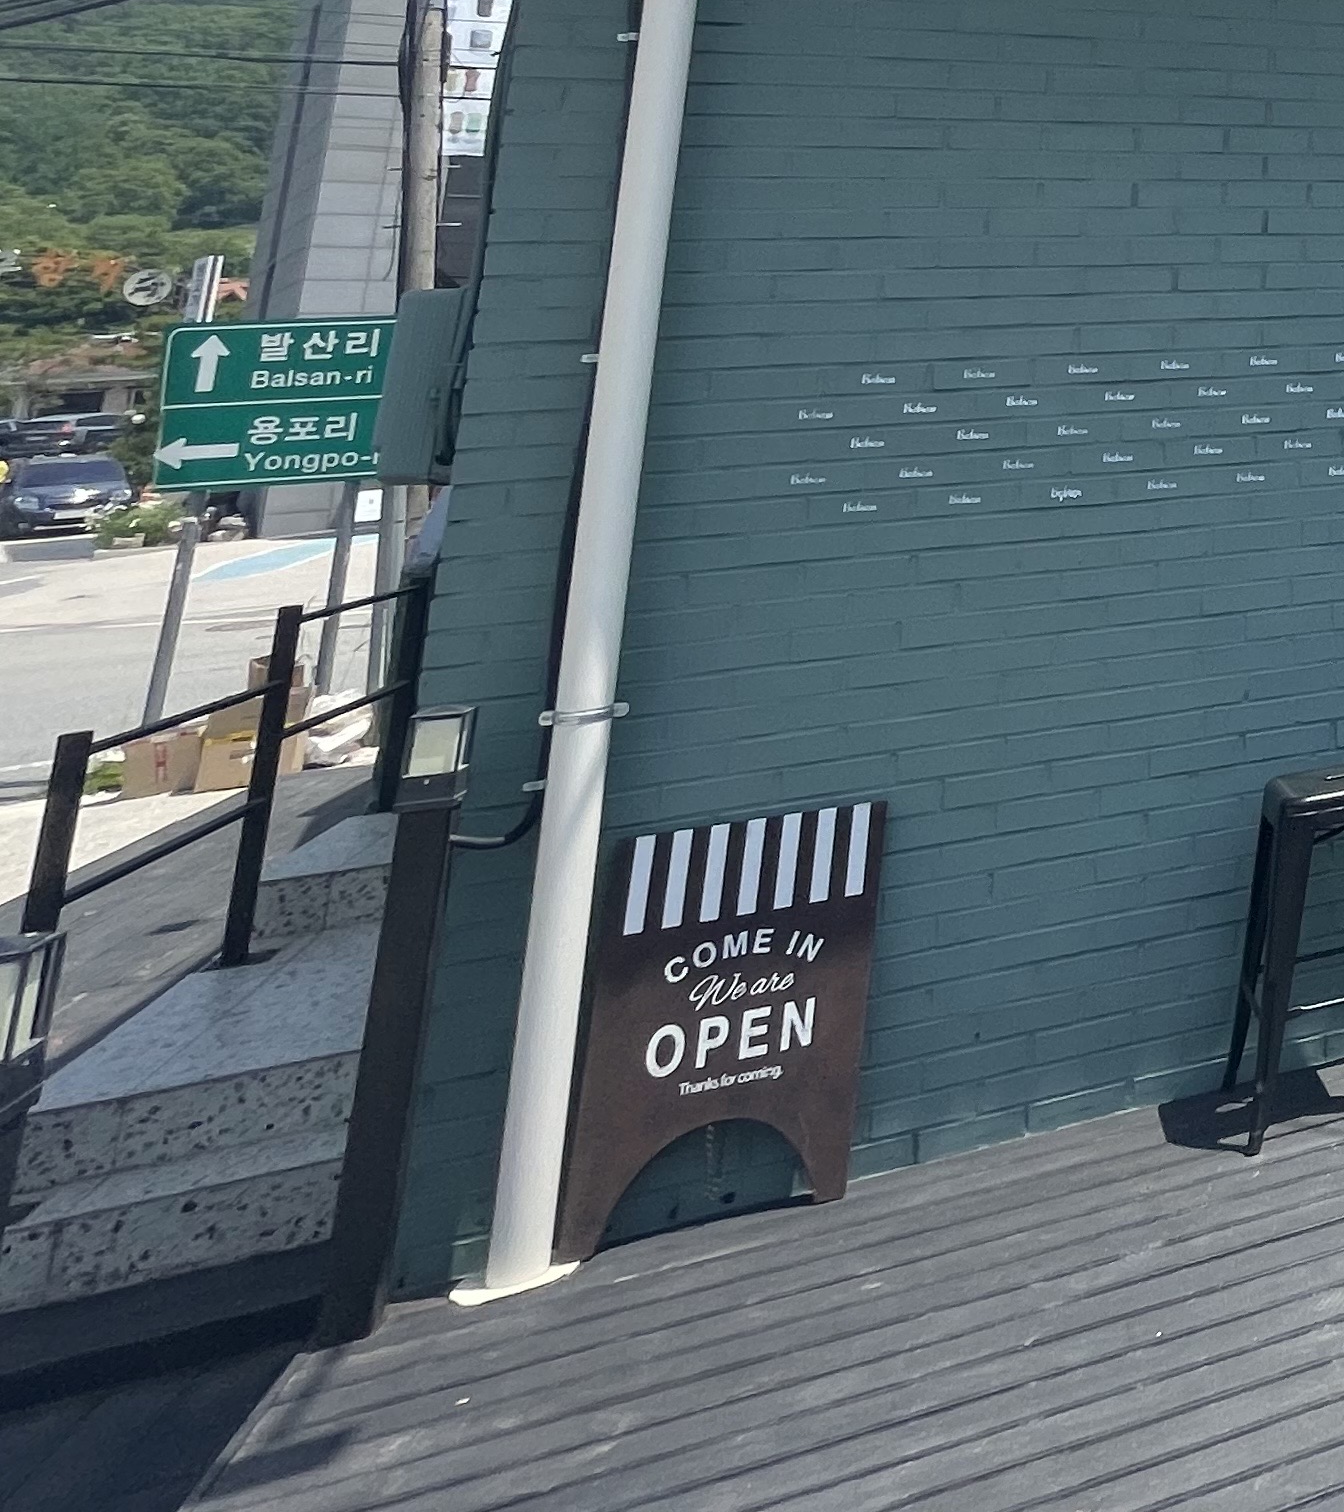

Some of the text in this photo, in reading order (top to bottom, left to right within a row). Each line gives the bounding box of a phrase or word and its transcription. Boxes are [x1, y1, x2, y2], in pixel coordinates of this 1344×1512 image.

[260, 328, 381, 362] 발산리
[250, 365, 373, 389] Balsan-ri
[247, 412, 358, 445] 용포리
[664, 928, 824, 983] COME IN
[688, 972, 794, 1011] We are
[645, 997, 816, 1078] OPEN
[679, 1077, 719, 1096] Thanks
[720, 1073, 736, 1087] for
